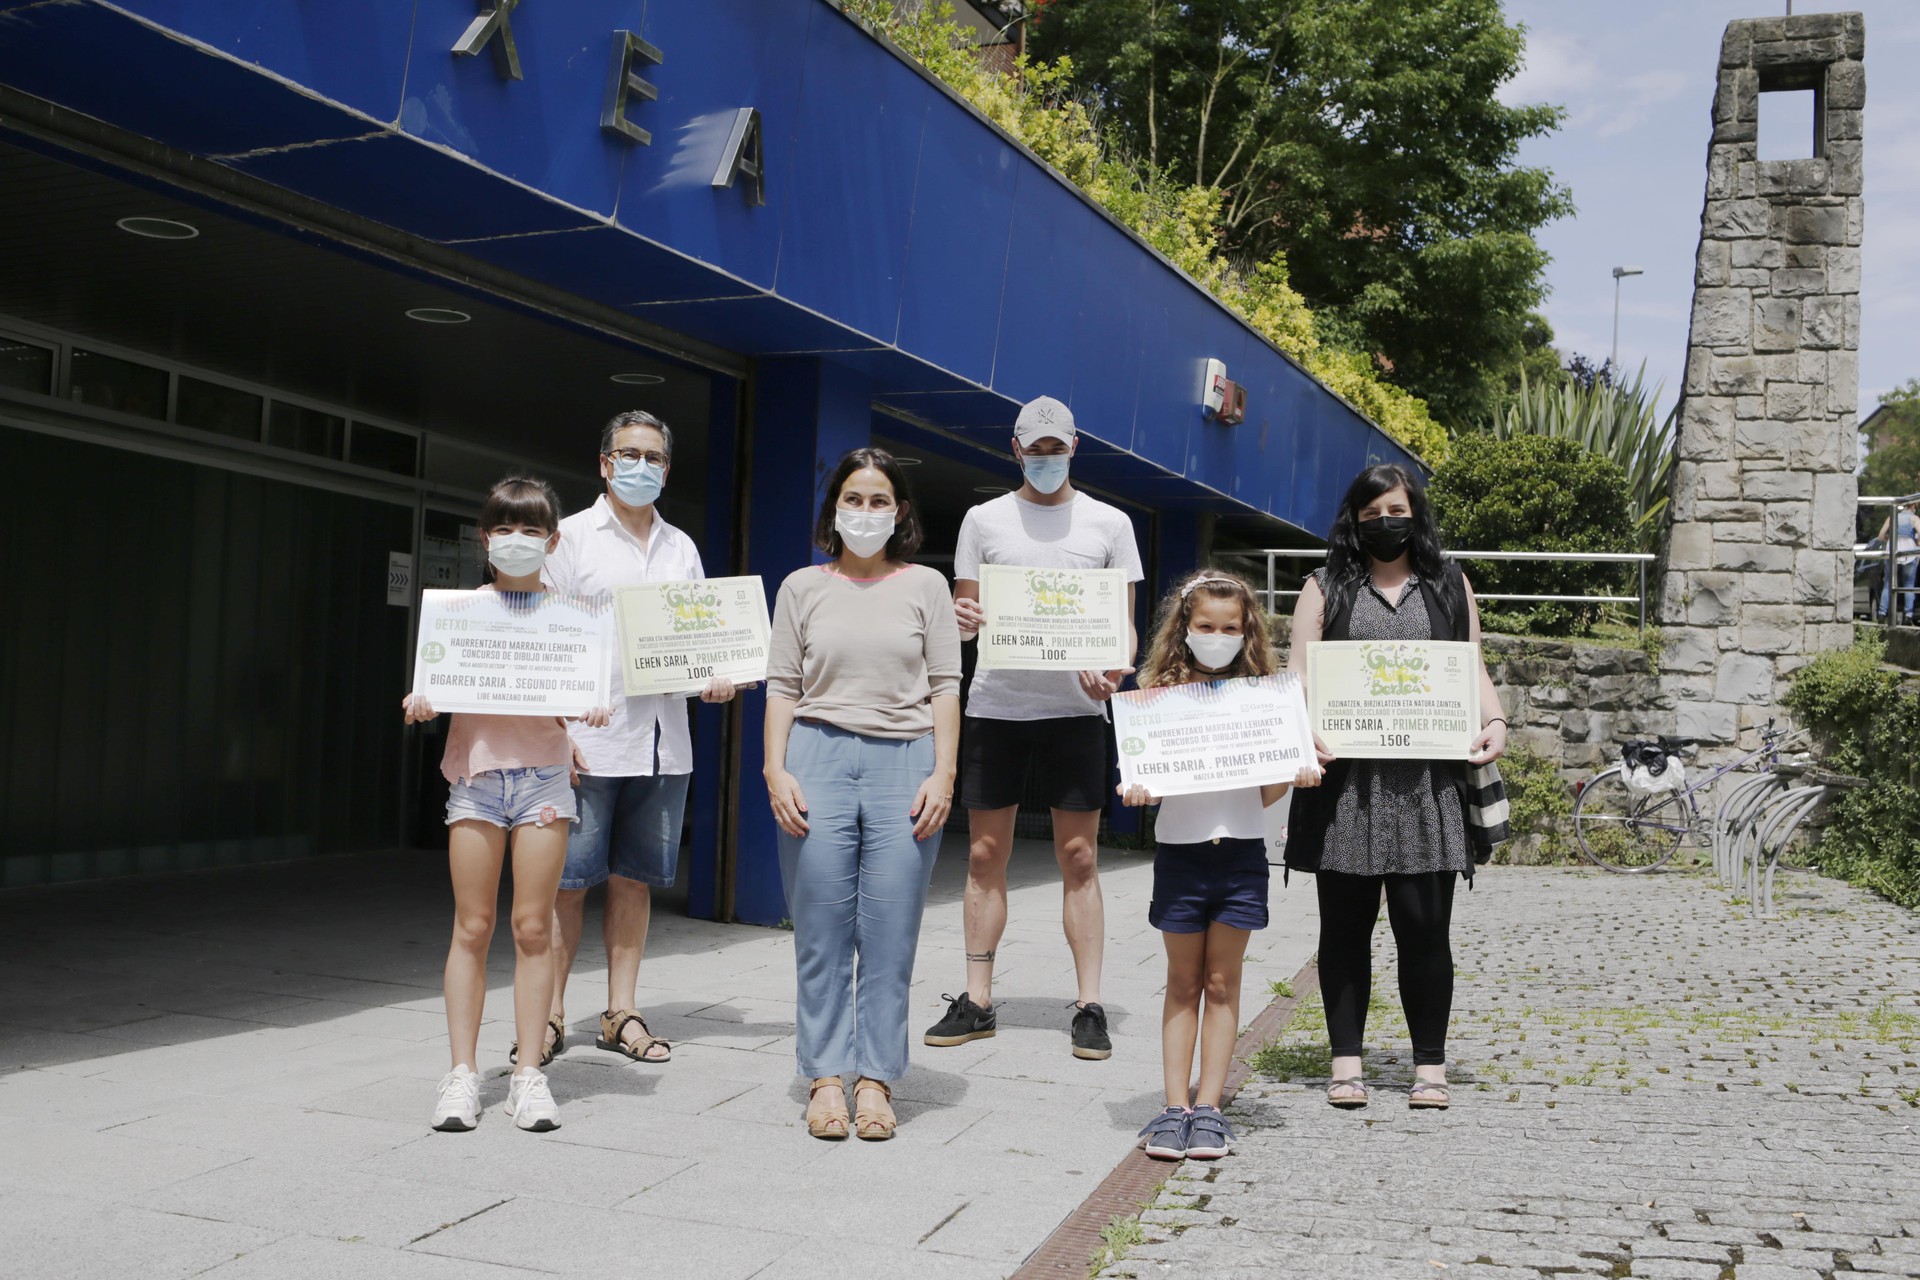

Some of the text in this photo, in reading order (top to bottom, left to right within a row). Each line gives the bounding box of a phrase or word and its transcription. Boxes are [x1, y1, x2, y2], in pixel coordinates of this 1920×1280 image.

[435, 618, 468, 631] GETXO
[558, 624, 582, 632] Getxo
[450, 638, 587, 653] HAURRENTZAKO MARRAZKI LEHIAKETA
[991, 634, 1017, 645] LEHEN
[1020, 635, 1044, 647] SARIA
[1051, 636, 1083, 647] PRIMER
[1086, 636, 1117, 648] PREMIO
[462, 649, 574, 663] CONCURSO DE DIBUJO INFANTIL
[635, 655, 661, 669] LEHEN
[663, 654, 689, 668] SARIA
[696, 650, 729, 665] PRIMER
[731, 646, 764, 661] PREMIO
[1041, 649, 1067, 660] 100€
[1366, 648, 1424, 670] Getxo
[687, 666, 714, 680] 100€
[430, 673, 476, 687] BIGARREN
[479, 676, 506, 688] SARIA
[515, 678, 557, 690] SEGUNDO
[560, 679, 595, 691] PREMIO
[1370, 674, 1422, 696] Berdea
[477, 692, 546, 702] LIBE MANZANO RAMIRO
[1328, 699, 1362, 708] KOZINATZEN,
[1363, 699, 1401, 708] BIRZIKLATZEN
[1436, 700, 1461, 708] ZAINTZEN
[1356, 708, 1391, 716] RECICLANDO
[1391, 708, 1396, 716] Y
[1396, 708, 1424, 716] CUIDANDO
[1425, 709, 1432, 717] LA
[1433, 709, 1467, 717] NATURALEZA
[1129, 713, 1162, 727] GETXO
[1322, 719, 1351, 731] LEHEN
[1355, 719, 1383, 731] SARIA
[1392, 718, 1429, 731] PRIMER
[1432, 719, 1467, 732] PREMIO
[1148, 717, 1283, 739] HAURRENTZAKO MARRAZKI LEHIAKETA
[1161, 728, 1273, 748] CONCURSO DE DIBUJO INFANTIL
[1380, 734, 1410, 747] 150€
[1137, 762, 1170, 775] LEHEN
[1173, 759, 1206, 772] SARIA
[1215, 753, 1256, 768] PRIMER
[1259, 747, 1300, 763] PREMIO
[1194, 768, 1249, 781] HAIZEA DE FRUTOS
